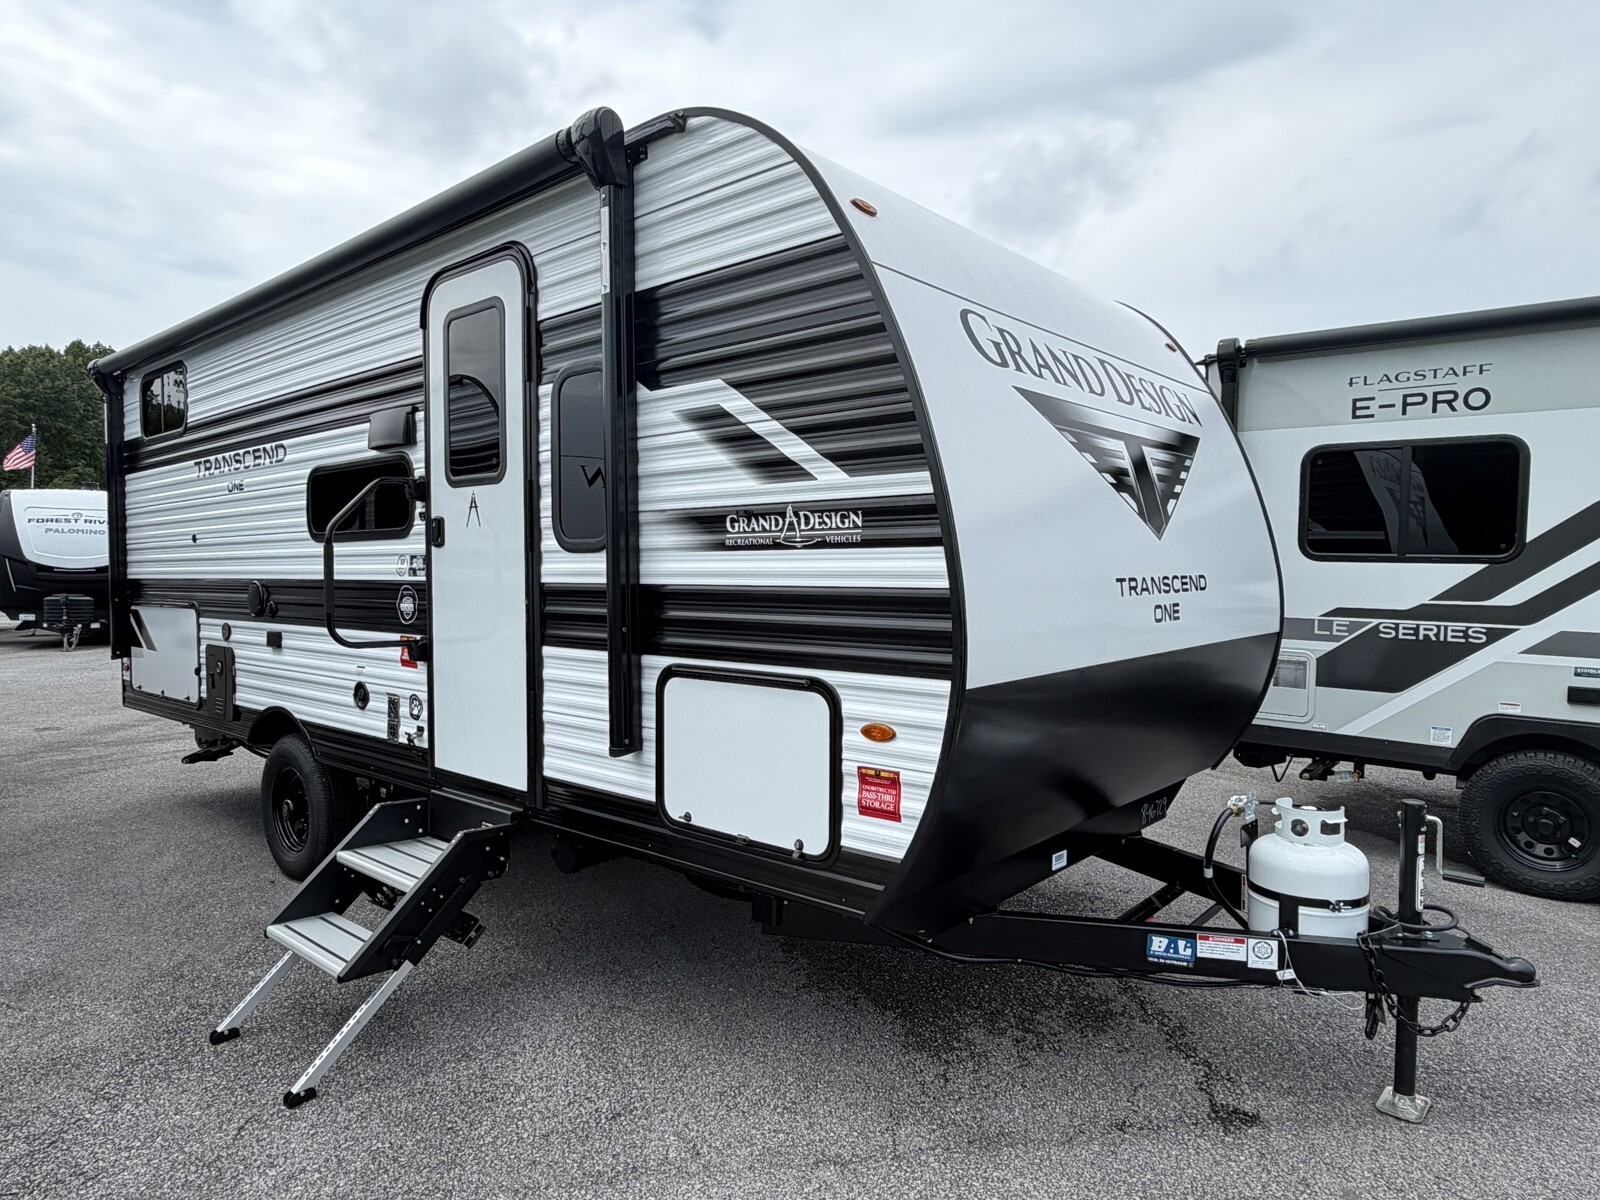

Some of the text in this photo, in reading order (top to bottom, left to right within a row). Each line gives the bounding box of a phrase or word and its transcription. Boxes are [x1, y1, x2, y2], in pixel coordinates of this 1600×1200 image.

[959, 308, 1202, 427] GRAND DESIGN
[1347, 363, 1493, 387] FLAGSTAFF
[1351, 387, 1491, 419] E-PRO
[194, 442, 287, 478] TRANSCEND
[227, 480, 244, 492] ONE
[45, 527, 106, 535] PALOMINO
[726, 511, 862, 532] GRAND DESIGN
[725, 534, 861, 546] RECREATIONAL VEHICLES
[1115, 575, 1207, 597] TRANSCEND
[1154, 602, 1180, 623] ONE
[1314, 618, 1487, 643] LE SERIES
[861, 799, 895, 811] STORAGE
